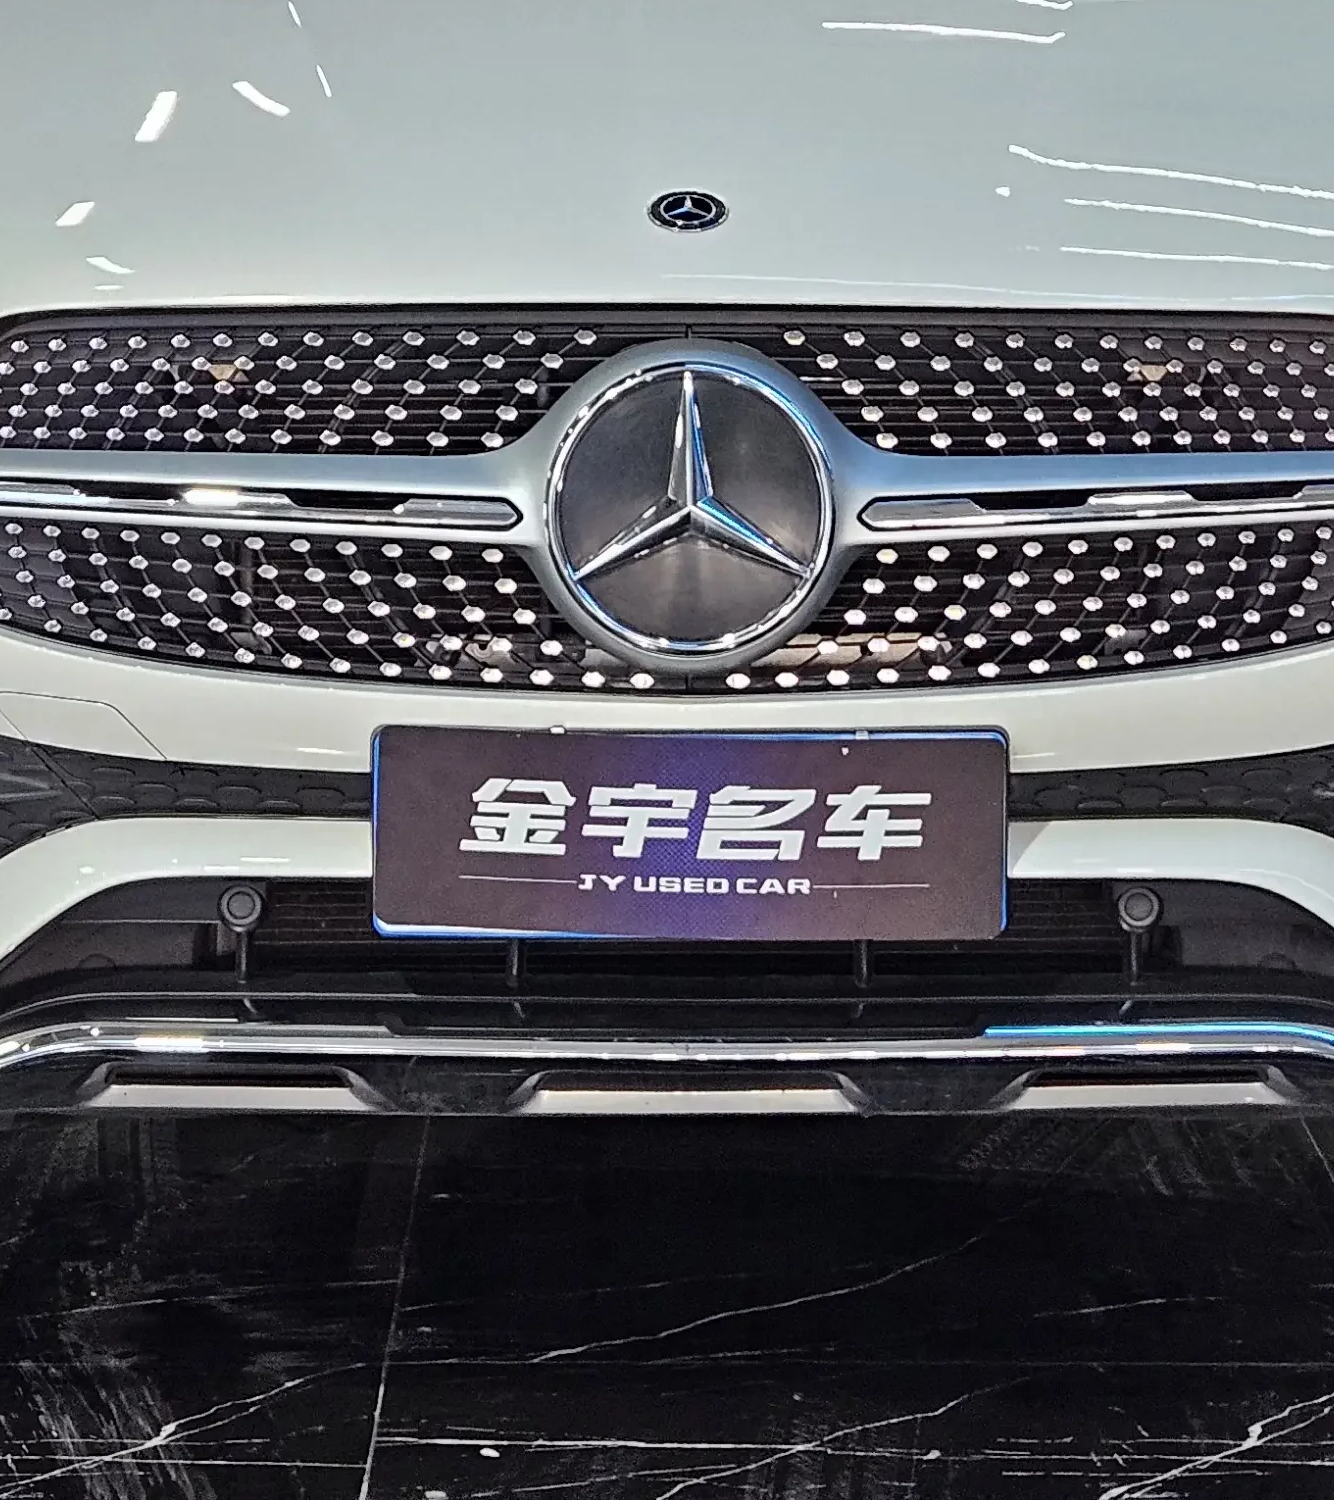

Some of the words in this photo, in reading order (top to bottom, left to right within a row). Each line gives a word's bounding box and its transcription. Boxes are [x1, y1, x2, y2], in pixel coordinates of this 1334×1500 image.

[458, 776, 933, 862] 金宇名车
[577, 873, 627, 892] JY
[633, 875, 730, 895] USED
[735, 877, 812, 895] CAR
